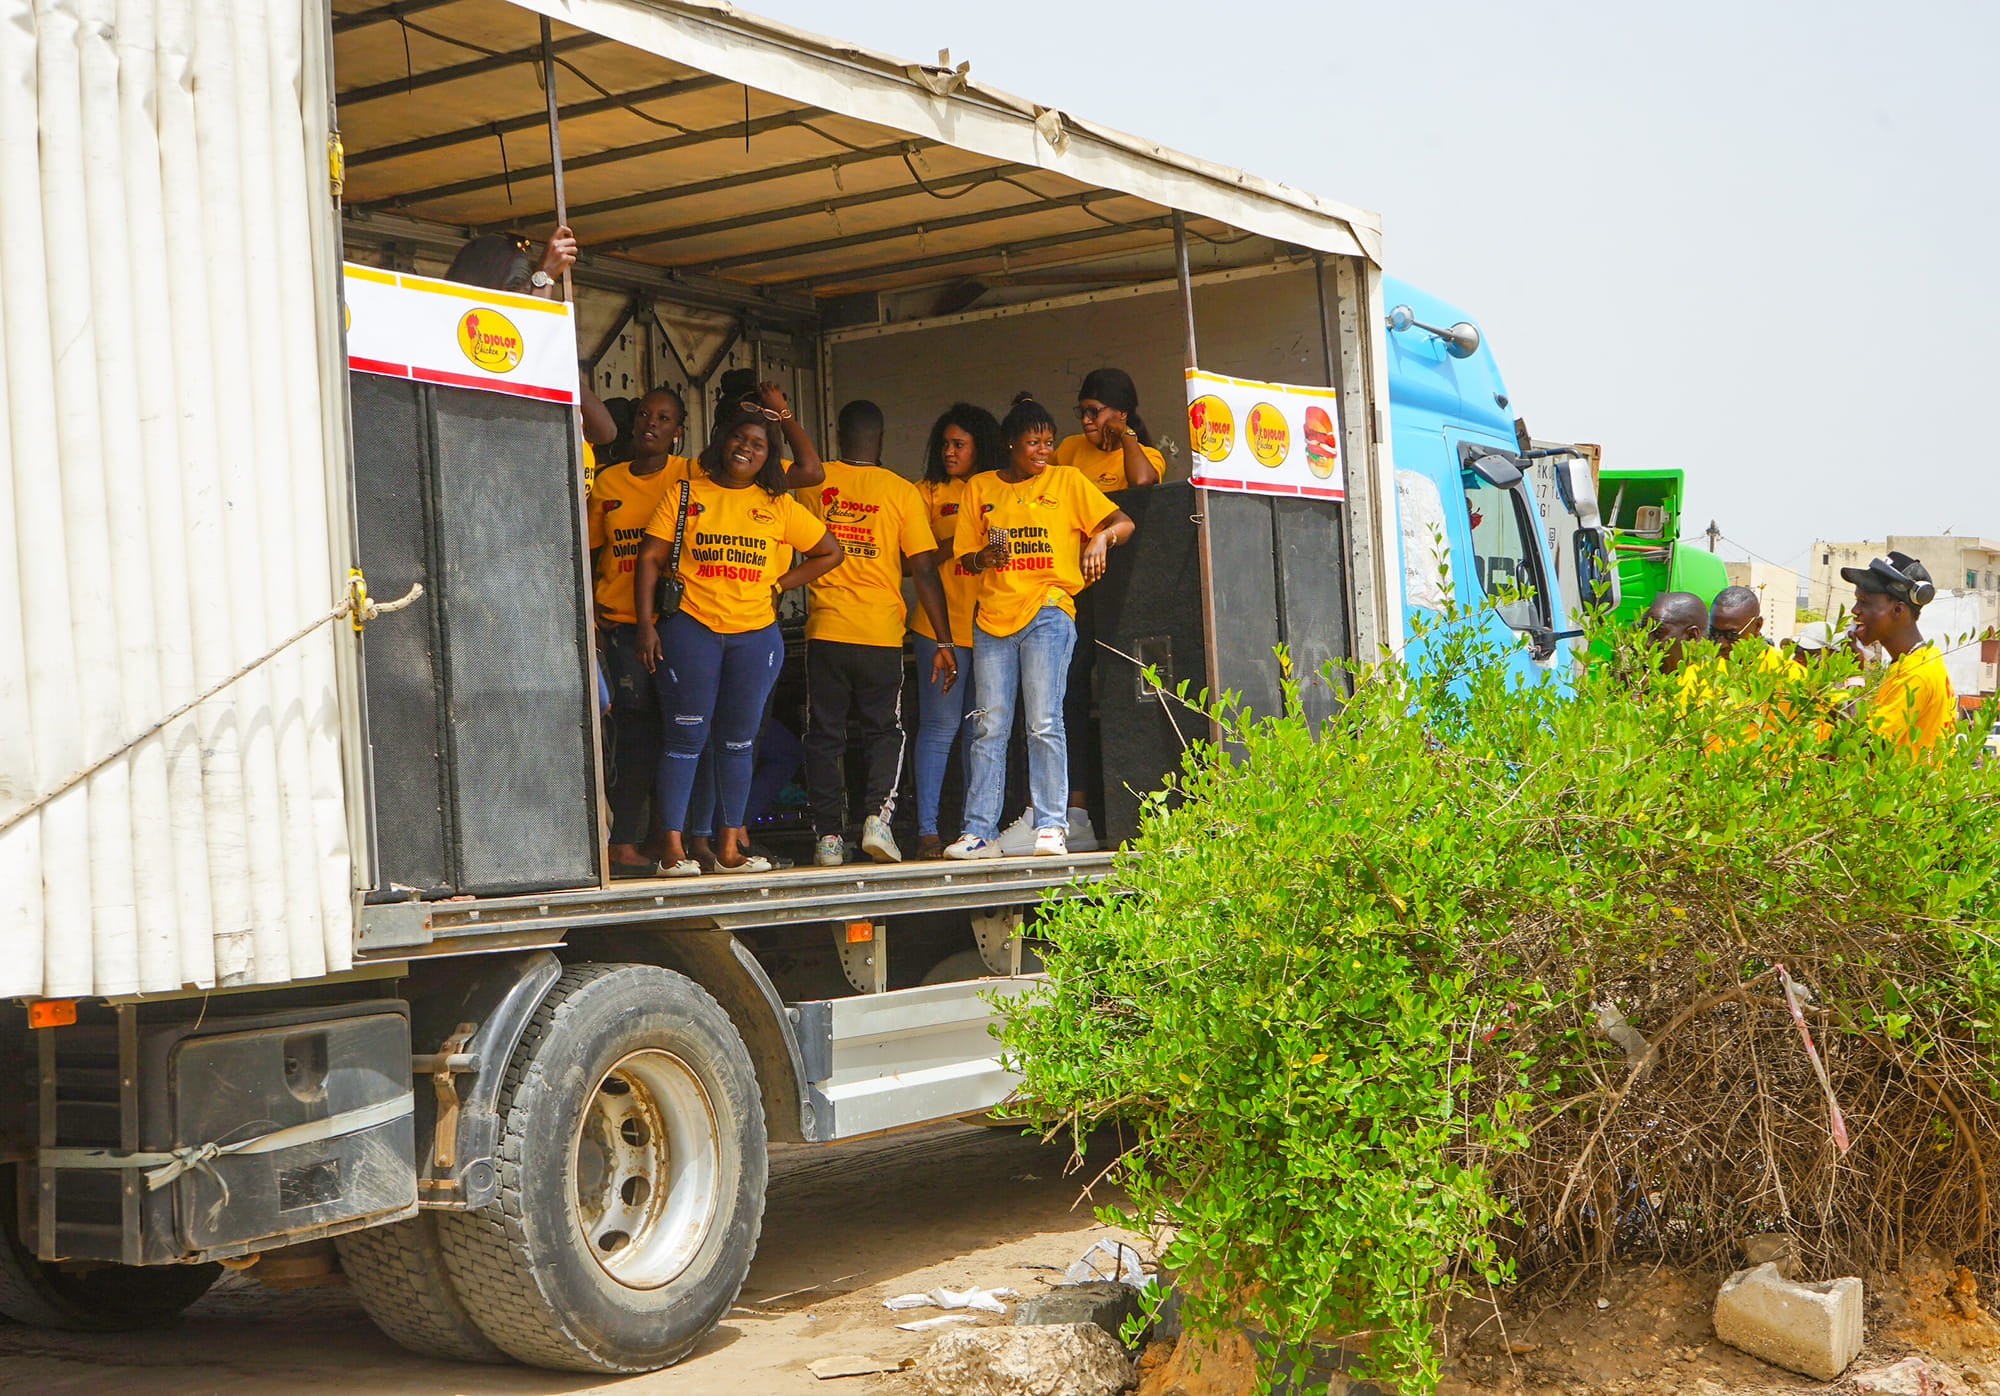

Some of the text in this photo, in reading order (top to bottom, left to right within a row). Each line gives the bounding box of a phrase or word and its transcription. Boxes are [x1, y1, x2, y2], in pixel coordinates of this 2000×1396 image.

[841, 501, 880, 513] DJOLOF
[825, 523, 872, 535] UFISQUE
[696, 532, 767, 550] Ouverture
[692, 548, 767, 567] Djolof Chicken
[696, 564, 763, 582] RUFISQUE
